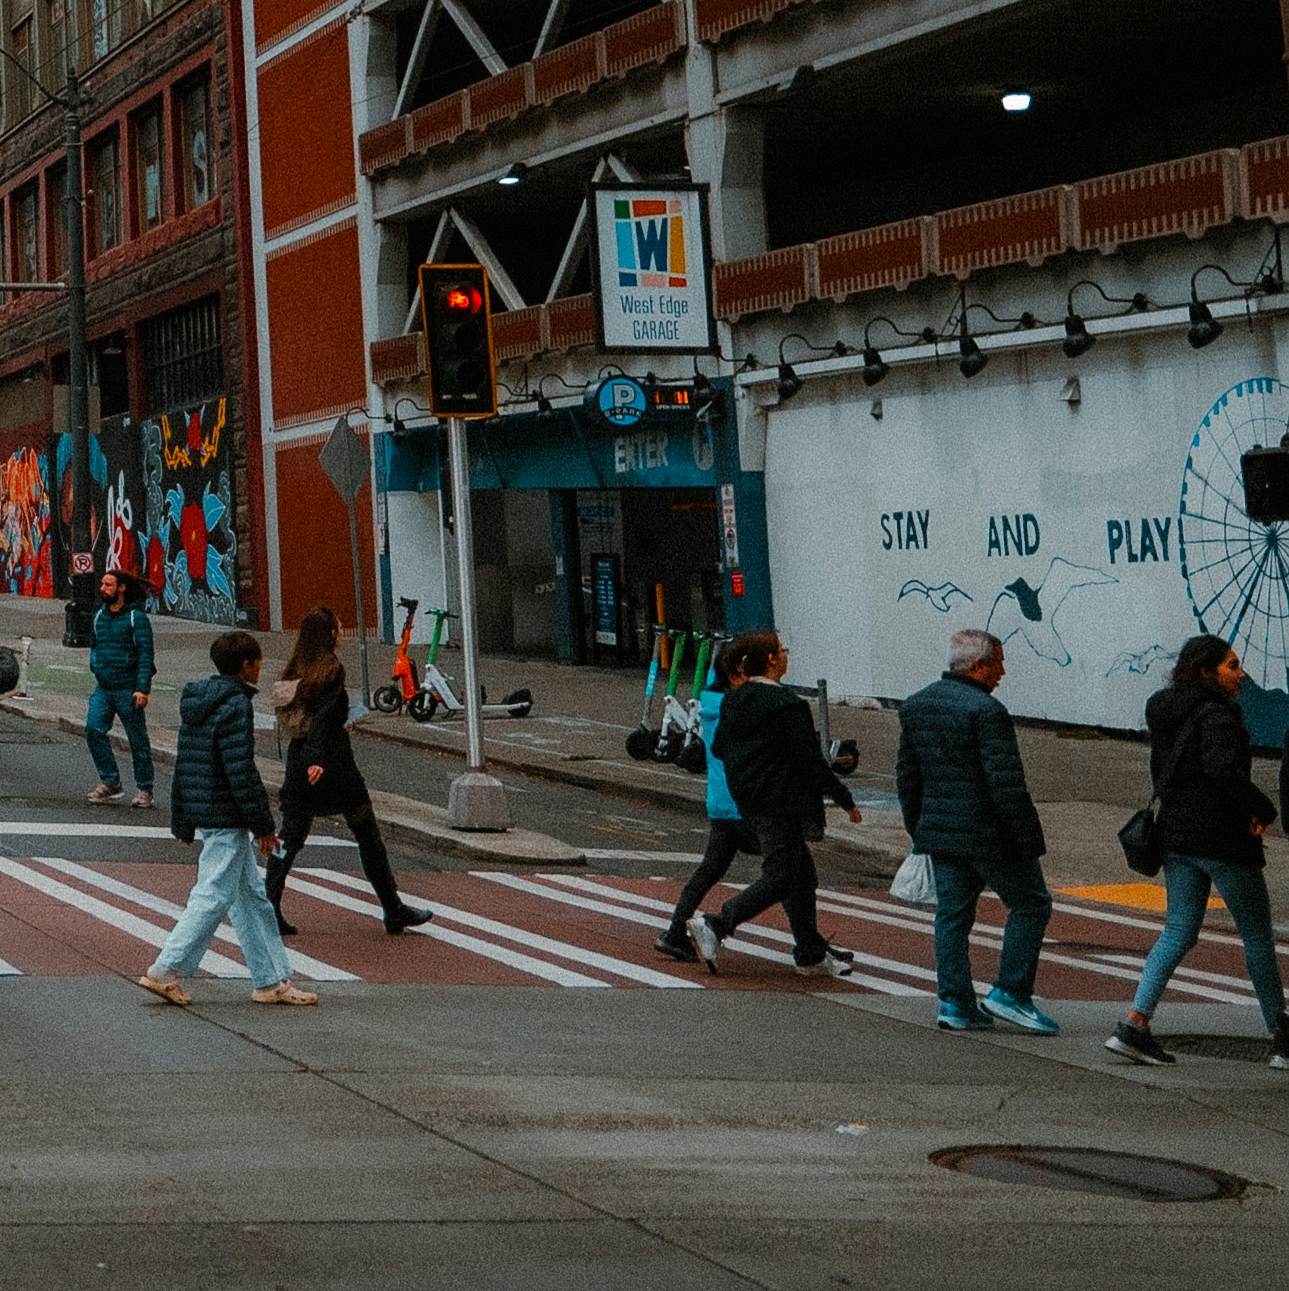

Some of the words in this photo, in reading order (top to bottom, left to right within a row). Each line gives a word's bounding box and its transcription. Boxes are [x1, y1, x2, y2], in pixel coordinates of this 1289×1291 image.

[634, 217, 668, 273] W
[620, 295, 654, 315] West
[659, 295, 689, 318] Edge
[632, 319, 680, 340] GARAGE
[612, 384, 636, 420] P
[614, 429, 669, 473] ENTER
[880, 509, 930, 551] STAY
[987, 513, 1041, 557] AND
[1106, 516, 1172, 564] PLAY
